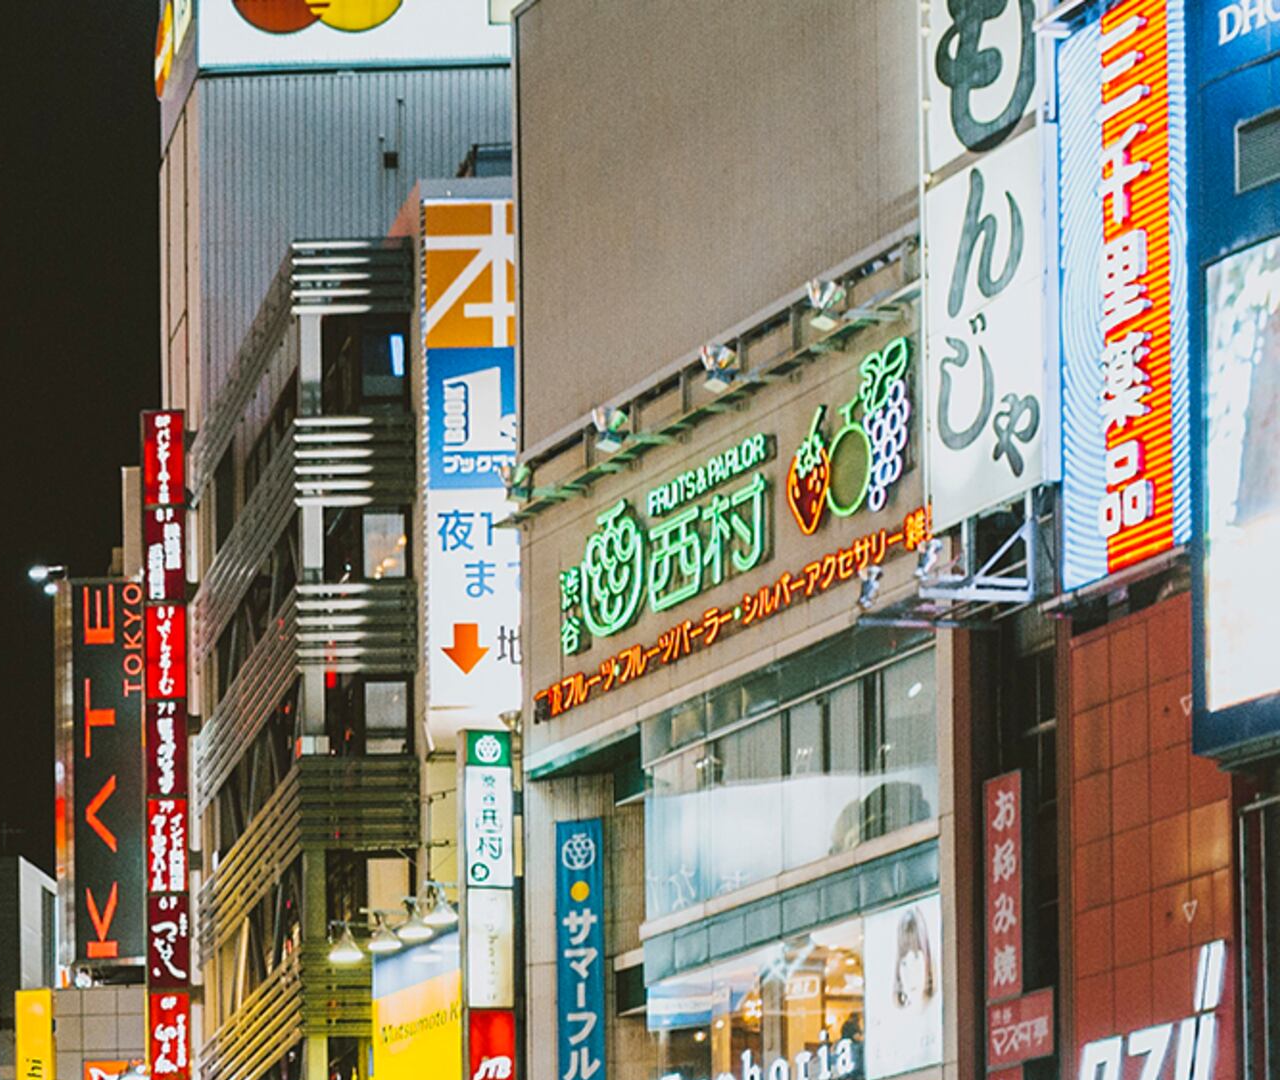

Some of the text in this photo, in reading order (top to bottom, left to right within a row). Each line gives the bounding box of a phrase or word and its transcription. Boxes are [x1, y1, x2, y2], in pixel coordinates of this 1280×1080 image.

[1098, 16, 1154, 538] 三千里薬品
[559, 566, 581, 656] 渋谷
[649, 472, 766, 614] 西村
[123, 583, 143, 697] TOKYO
[83, 583, 119, 960] KATE
[992, 790, 1018, 987] お好み焼
